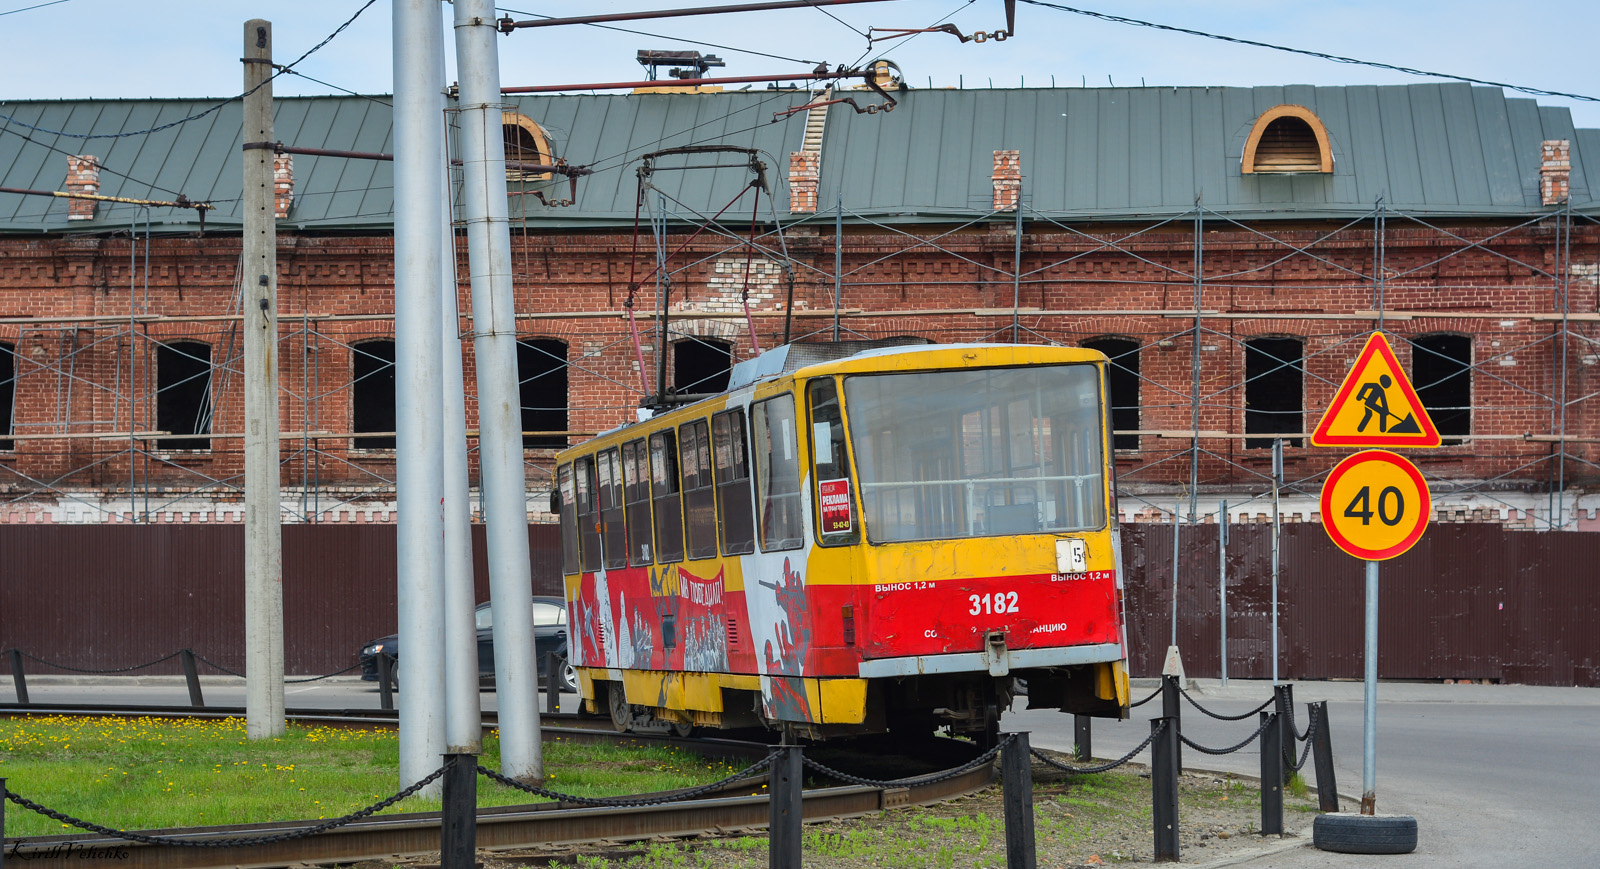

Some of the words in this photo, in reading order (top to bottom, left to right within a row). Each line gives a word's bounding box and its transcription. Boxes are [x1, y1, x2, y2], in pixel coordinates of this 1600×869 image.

[822, 494, 848, 505] РЕКЛАМА
[1344, 485, 1405, 526] 40
[1073, 547, 1082, 563] 5
[1050, 572, 1087, 582] ВЫНОС
[1089, 571, 1101, 581] 1,2
[875, 582, 912, 592] ВЫНОС
[914, 581, 927, 591] 1,2
[968, 591, 1020, 616] 3182
[1030, 622, 1067, 635] АНЦИЮ
